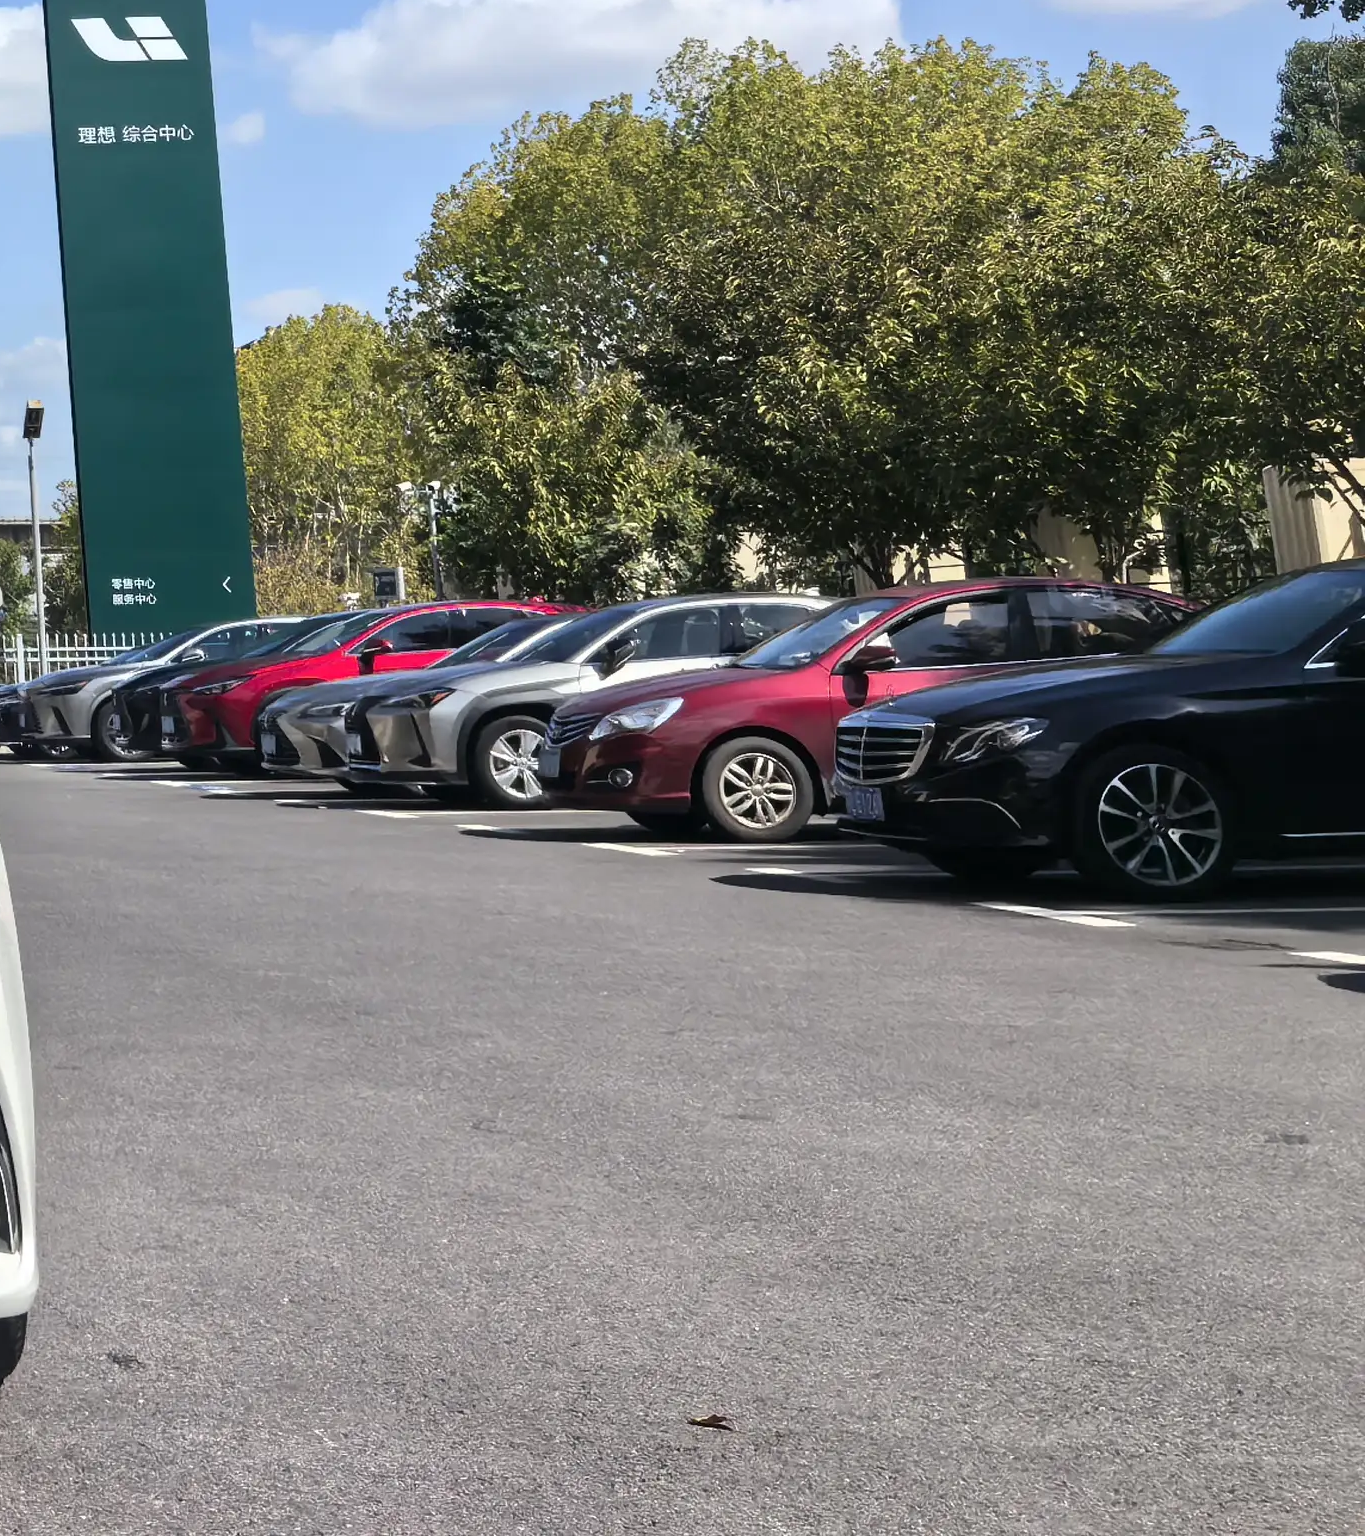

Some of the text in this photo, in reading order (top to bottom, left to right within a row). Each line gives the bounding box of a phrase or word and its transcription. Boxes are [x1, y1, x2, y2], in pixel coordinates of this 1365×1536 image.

[78, 124, 195, 144] 理想 综合中心
[111, 577, 156, 590] 零售中心
[112, 593, 157, 606] 服务中心
